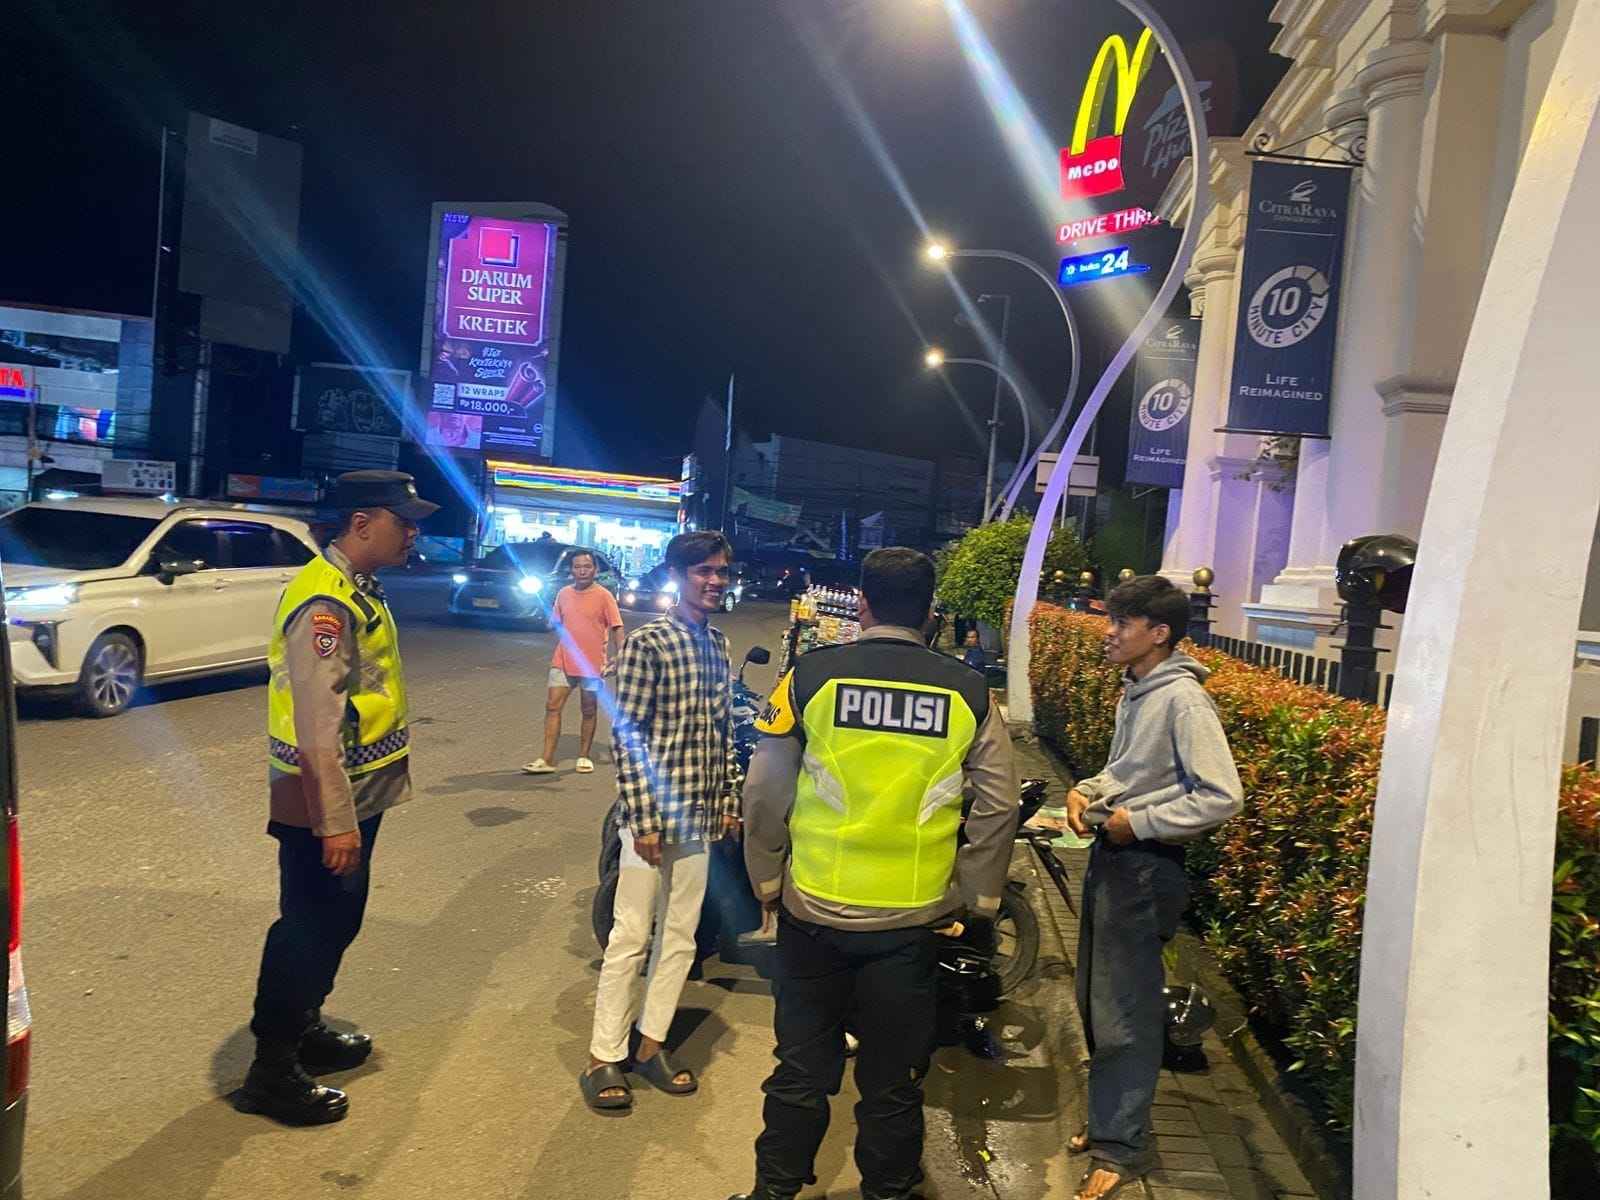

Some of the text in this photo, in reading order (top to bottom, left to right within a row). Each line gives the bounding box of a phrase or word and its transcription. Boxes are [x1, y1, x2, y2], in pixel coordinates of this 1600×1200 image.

[1068, 158, 1119, 180] McDo
[1060, 217, 1108, 241] DRIVE
[1101, 250, 1129, 275] 24
[461, 268, 532, 289] DJARUM
[467, 286, 523, 305] SUPER
[1268, 287, 1302, 316] 10
[459, 315, 528, 336] KRETEK
[1250, 301, 1323, 344] MINUTE CITY
[1266, 373, 1299, 386] LIFE
[462, 385, 505, 397] 12 WRAPS
[1152, 392, 1173, 411] 10
[1239, 386, 1323, 401] REIMAGINED
[1133, 454, 1185, 465] REIMAGED
[840, 688, 945, 733] POLISI
